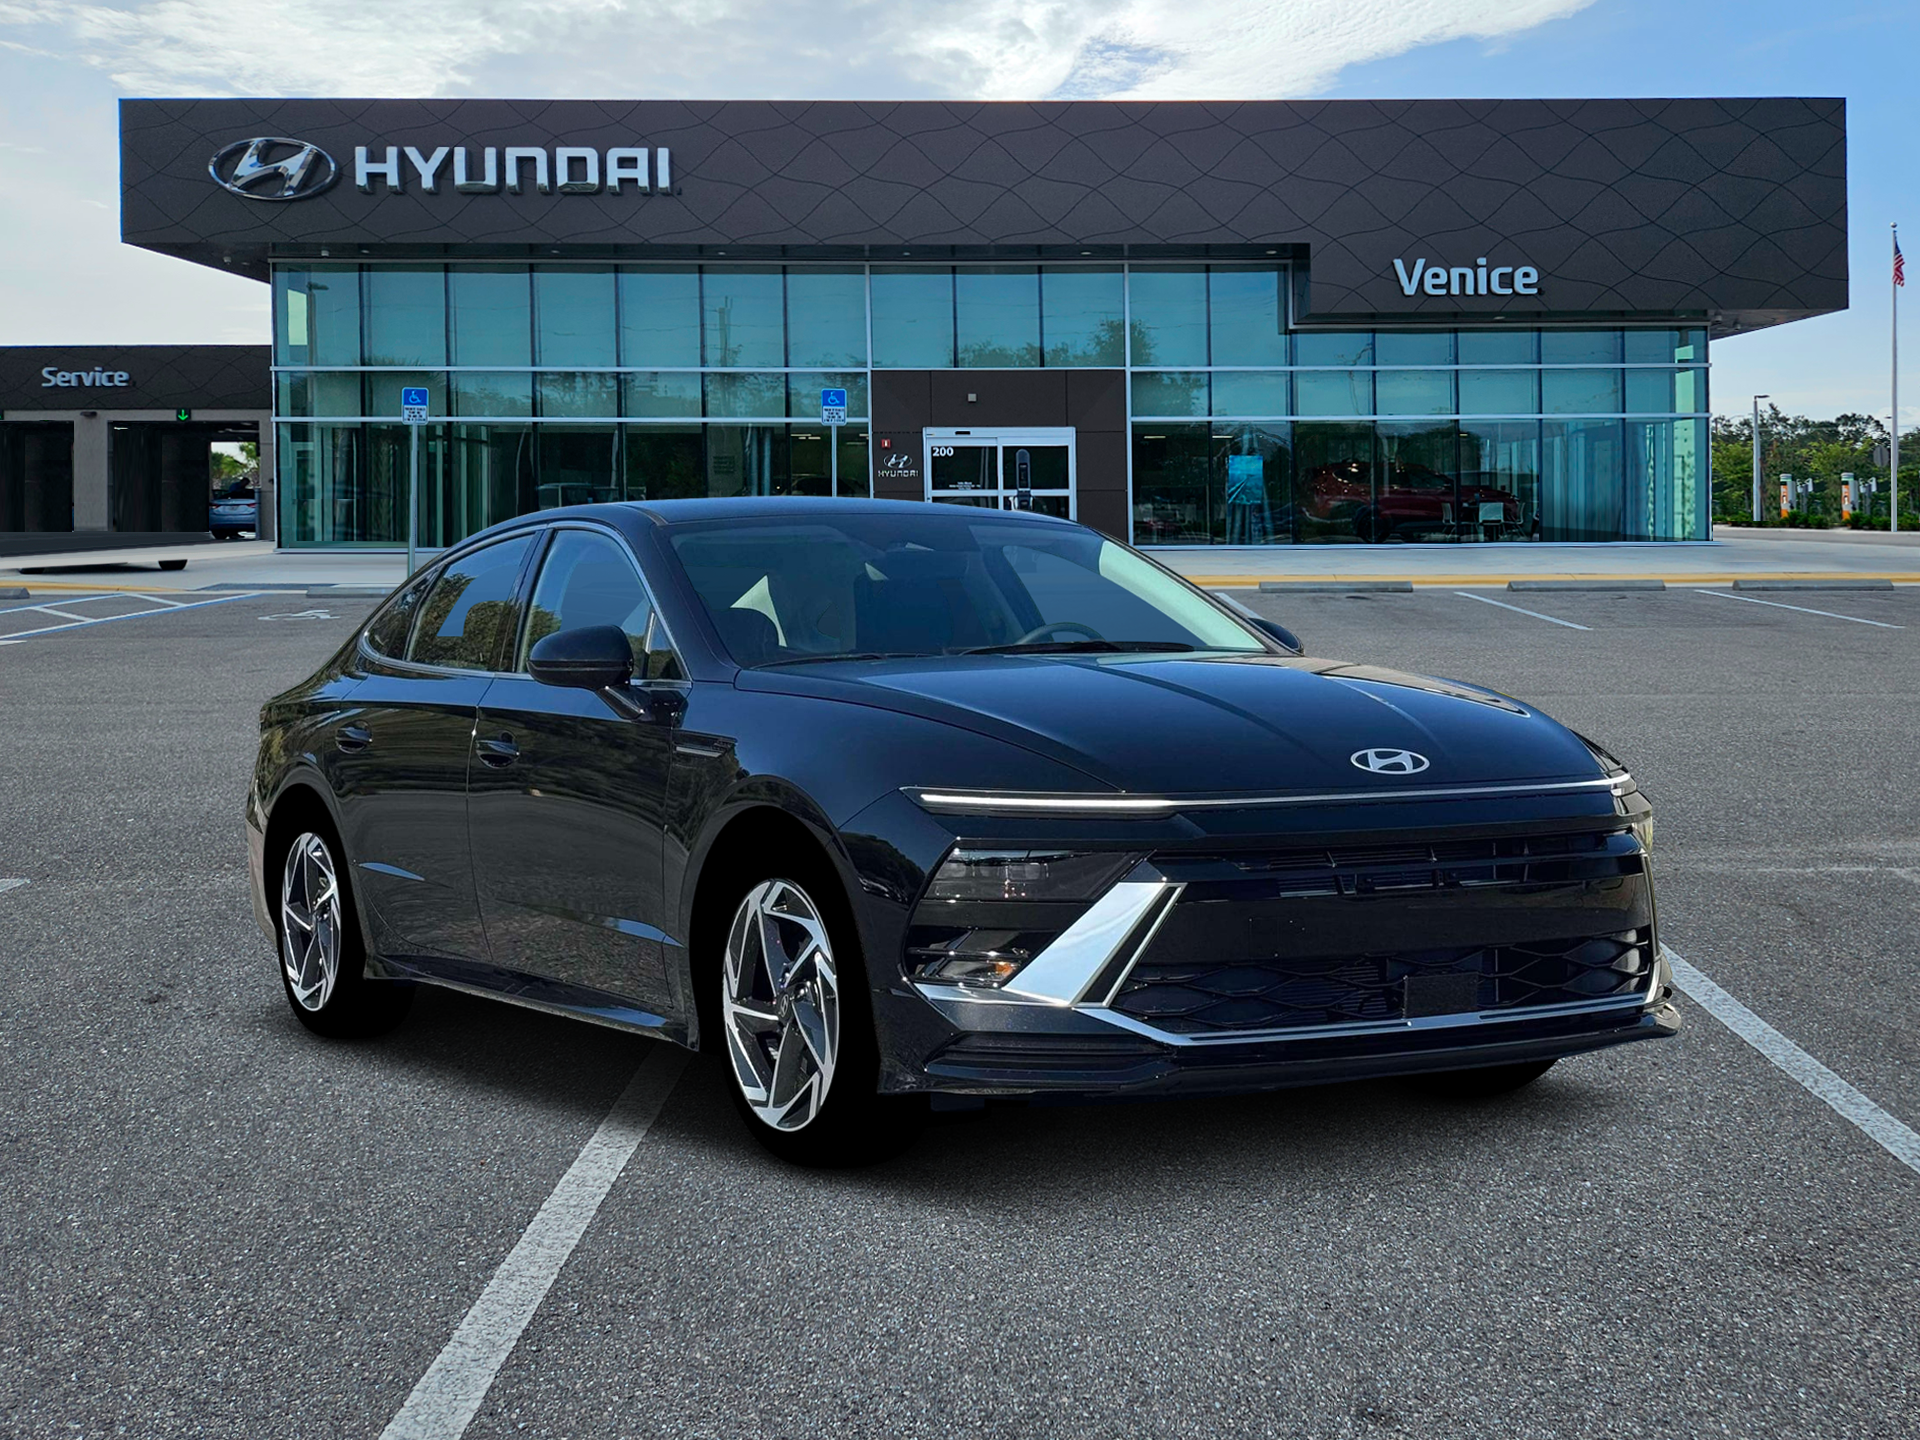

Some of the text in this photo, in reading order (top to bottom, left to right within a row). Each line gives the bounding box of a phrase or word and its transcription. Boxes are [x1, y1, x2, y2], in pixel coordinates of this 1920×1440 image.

[354, 146, 673, 194] HYUNDAI
[1393, 257, 1539, 296] Venice
[41, 366, 130, 387] Service
[932, 446, 954, 457] 200
[877, 470, 919, 478] HYUNDAI
